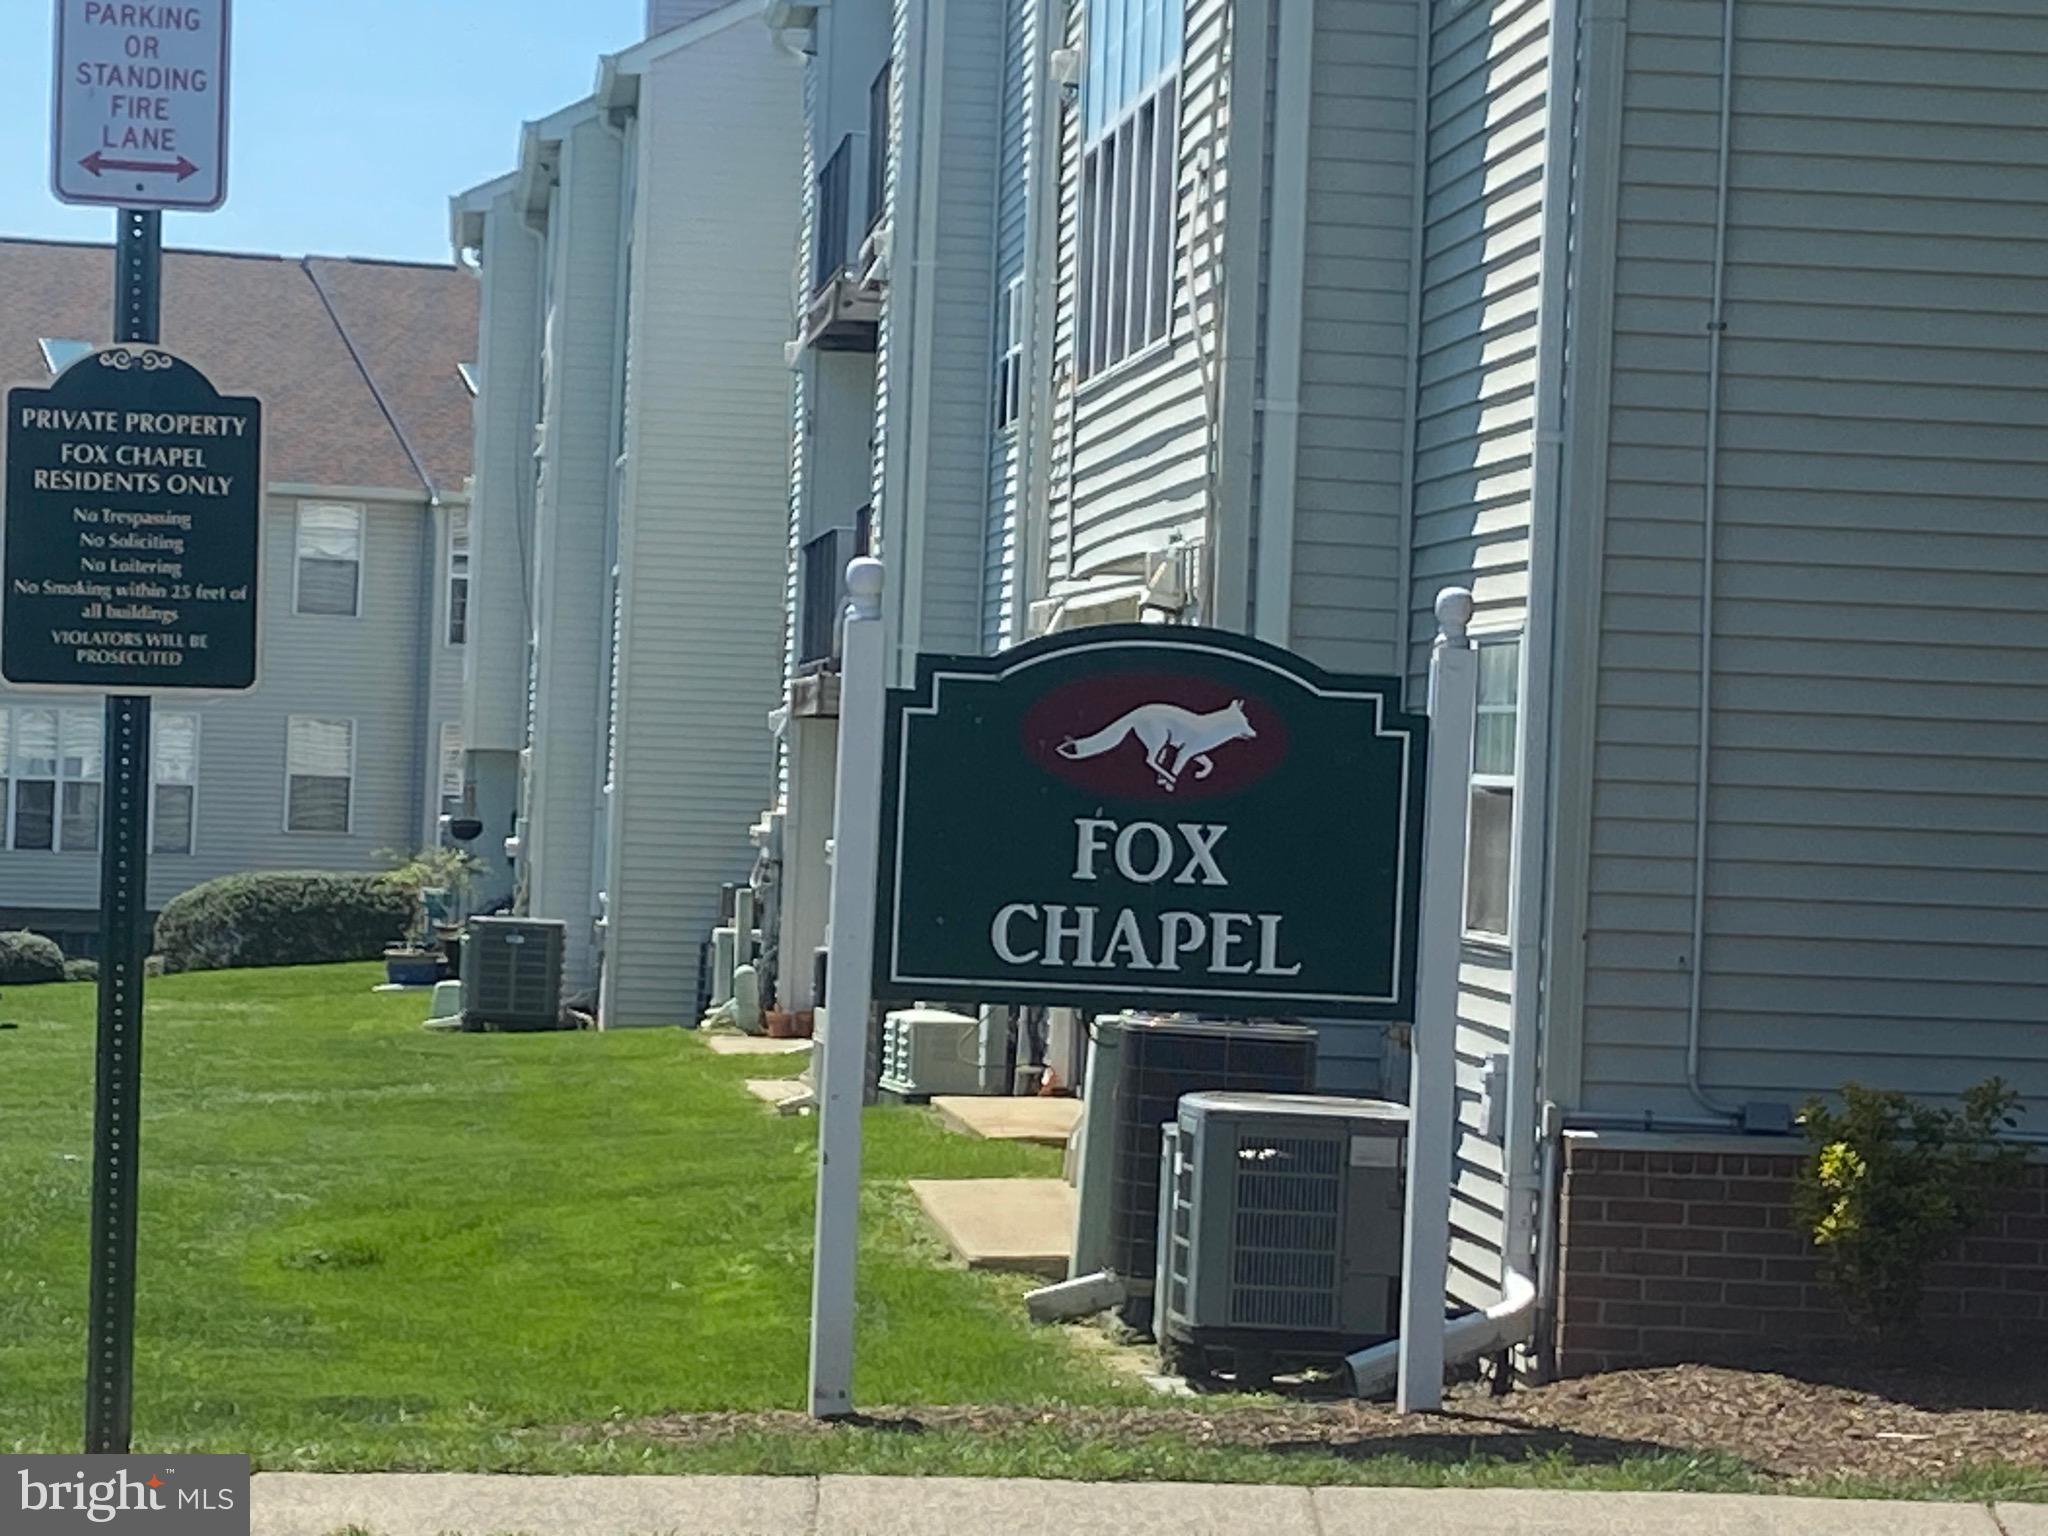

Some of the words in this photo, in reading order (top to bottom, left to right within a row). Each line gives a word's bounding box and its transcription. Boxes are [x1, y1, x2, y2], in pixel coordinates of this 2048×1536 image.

[84, 1, 201, 31] PARKING
[124, 35, 159, 59] OR
[76, 62, 207, 92] STANDING
[111, 95, 170, 121] FIRE
[102, 124, 176, 151] LANE
[22, 408, 118, 432] PRIVATE
[125, 412, 247, 436] PROPERTY
[61, 443, 109, 464] FOX
[115, 445, 206, 468] CHAPEL
[34, 469, 160, 493] RESIDENTS
[166, 474, 233, 496] ONLY
[73, 507, 98, 523] No
[102, 508, 192, 530] Trespassing
[79, 532, 105, 548] No
[108, 533, 185, 554] Soliciting
[80, 557, 106, 572] No
[110, 558, 182, 579] Loitering
[13, 579, 39, 594] No
[42, 579, 112, 600] Smoking
[116, 582, 167, 599] within
[171, 584, 191, 599] 25
[196, 583, 226, 601] feet
[229, 585, 247, 601] of
[81, 603, 102, 619] all
[106, 604, 179, 625] buildings
[51, 629, 143, 647] VIOLATORS
[145, 632, 184, 648] WILL
[189, 634, 208, 648] BE
[76, 650, 183, 666] PROSECUTED
[1071, 815, 1228, 887] FOX
[990, 903, 1302, 977] CHAPEL
